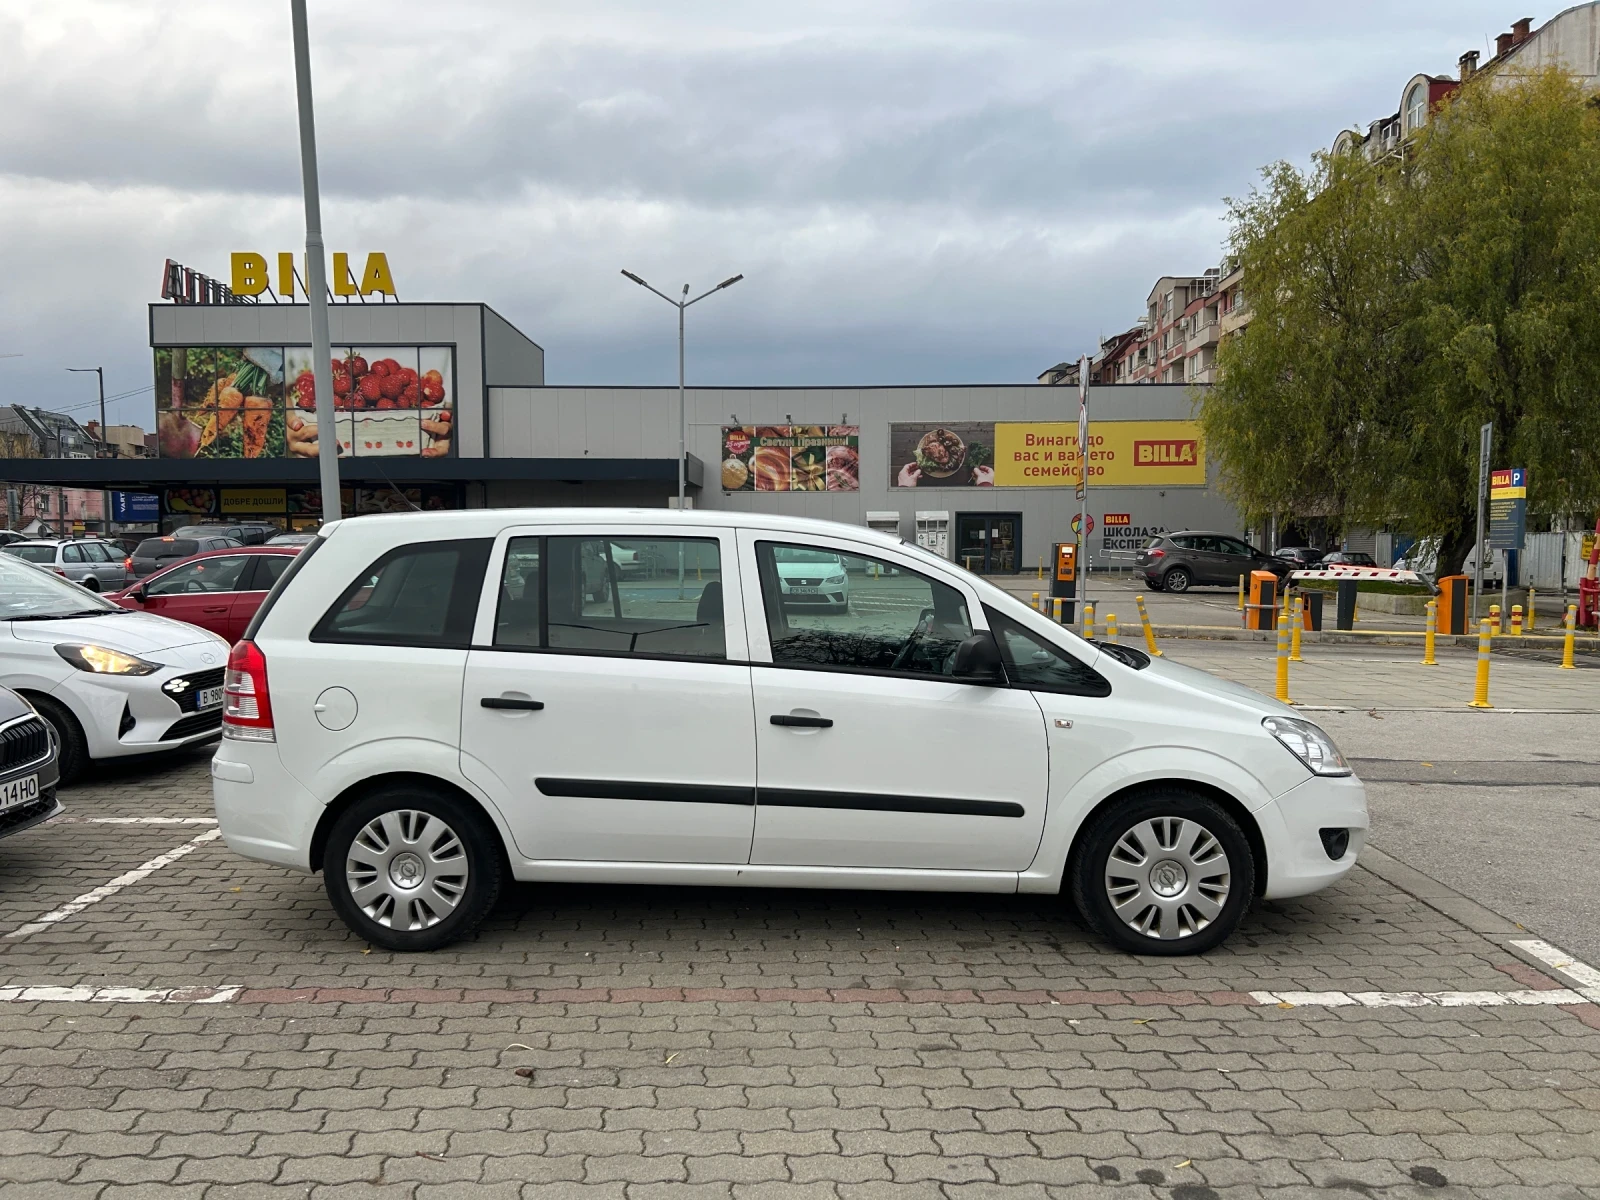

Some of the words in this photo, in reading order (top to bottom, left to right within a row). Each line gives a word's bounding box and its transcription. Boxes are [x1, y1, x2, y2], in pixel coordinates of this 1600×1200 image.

[231, 252, 397, 296] BILA
[1088, 435, 1104, 447] до
[1014, 451, 1039, 462] вас
[1044, 451, 1053, 461] и
[1057, 450, 1115, 461] ваето
[1138, 444, 1193, 463] BILLA
[1023, 463, 1105, 476] семейсво
[1492, 475, 1510, 486] BILLA
[1513, 472, 1520, 485] P
[223, 496, 250, 506] ДОБРЕ
[252, 495, 284, 506] ДОШЛИ
[1105, 515, 1129, 524] BILLA
[1103, 526, 1149, 537] ШКОЛА
